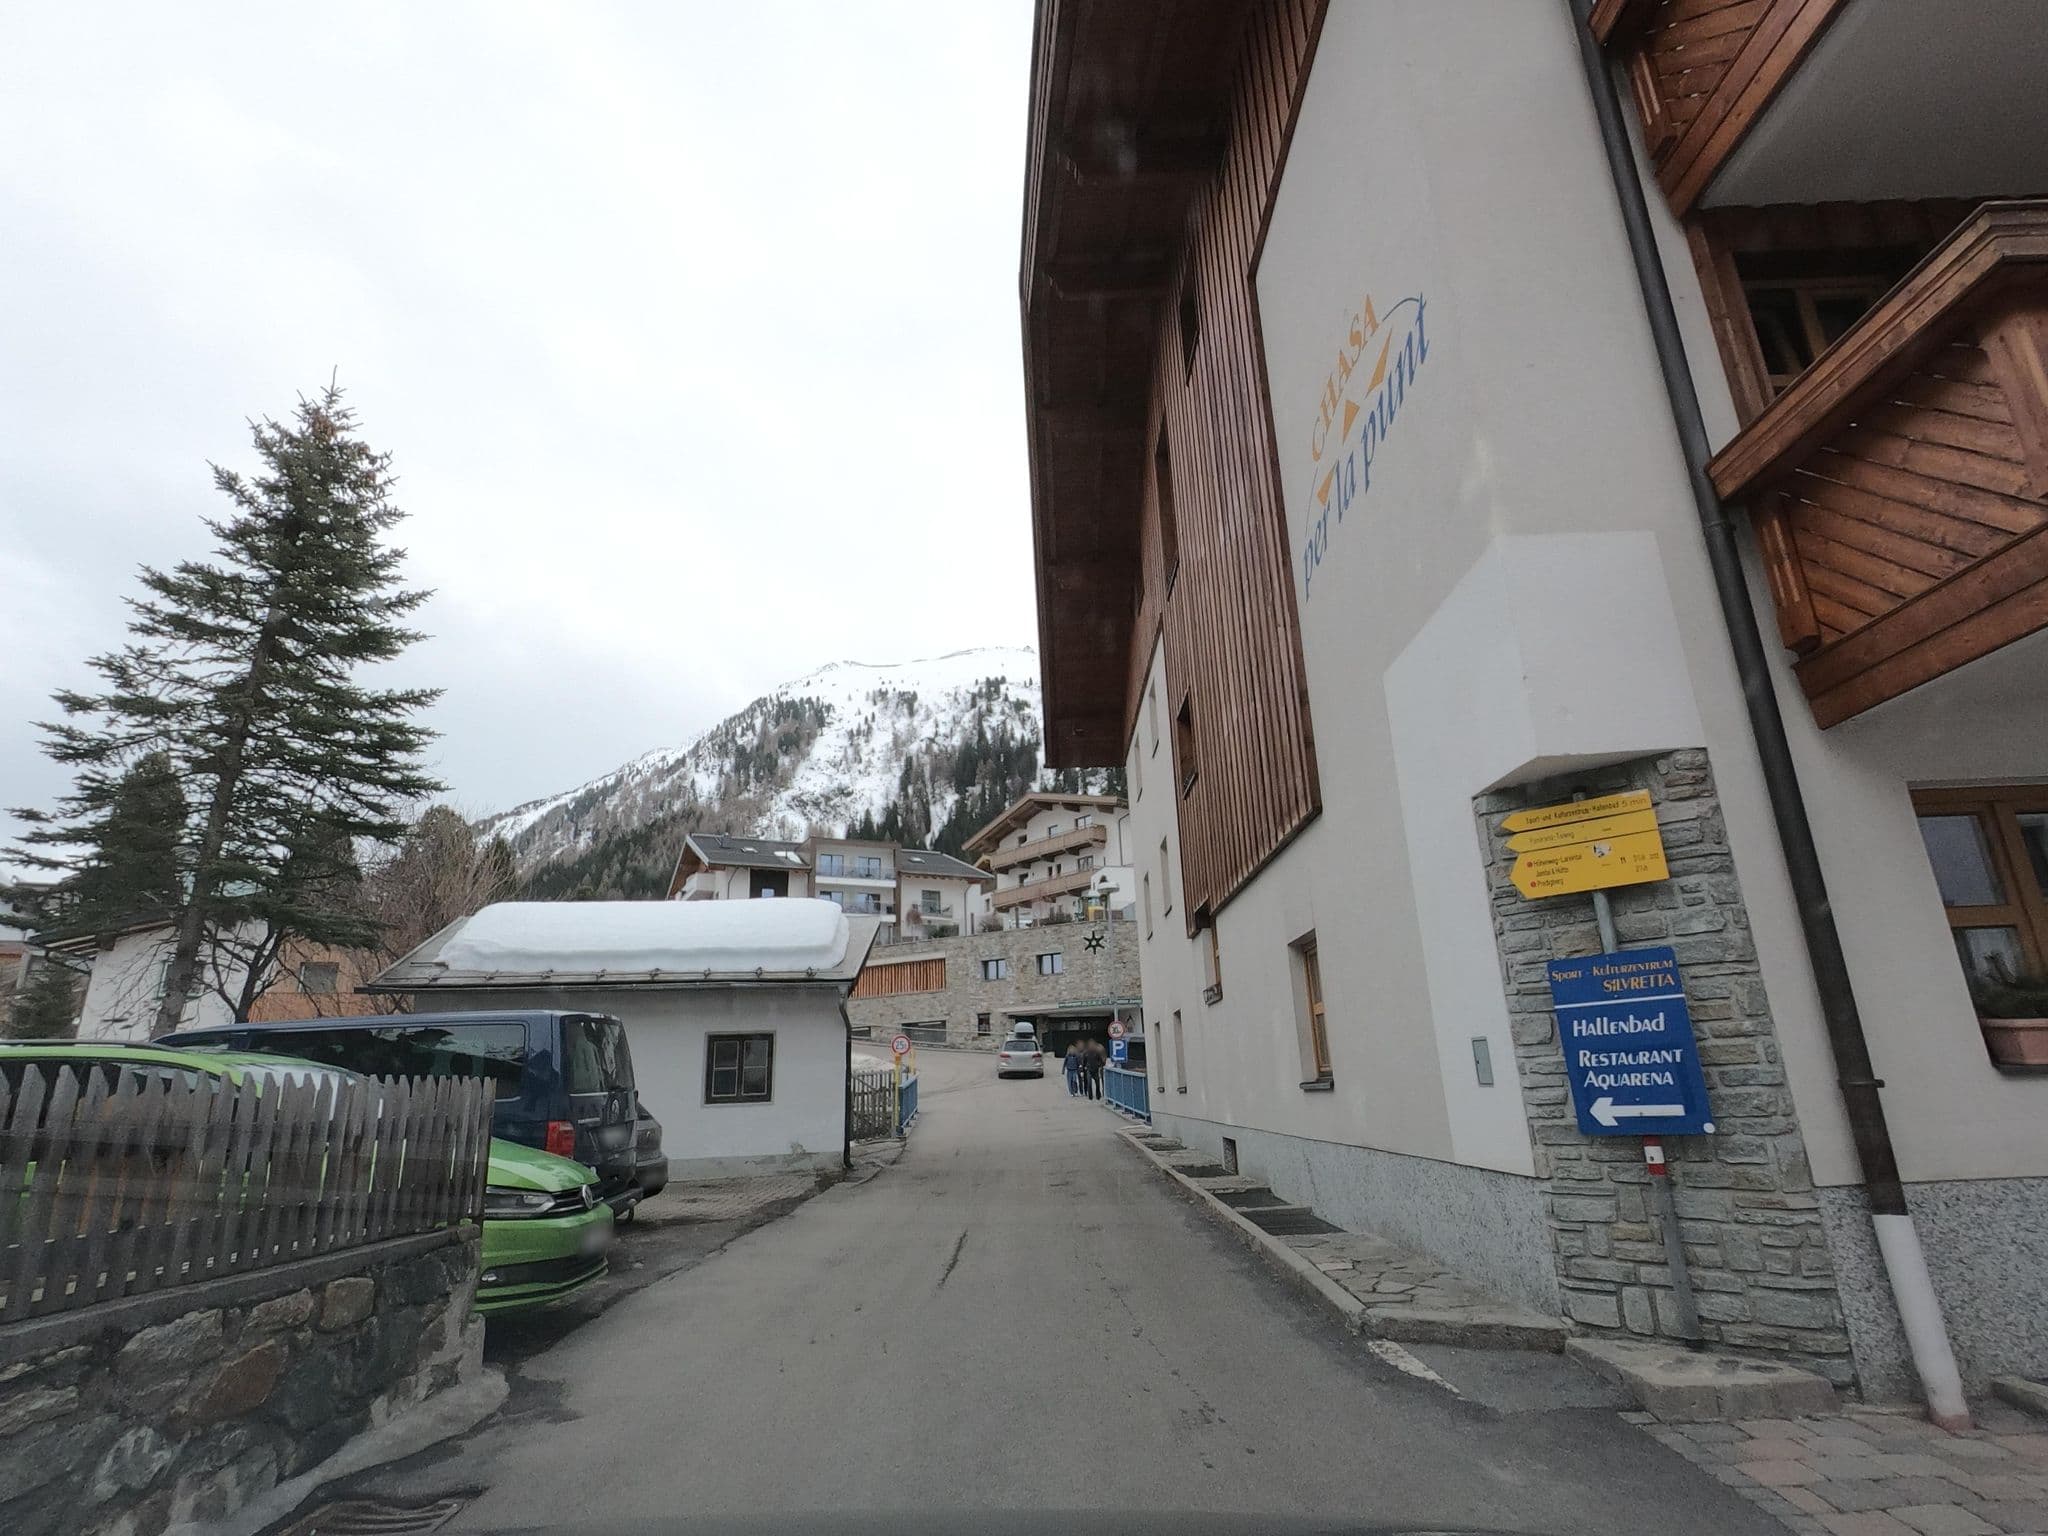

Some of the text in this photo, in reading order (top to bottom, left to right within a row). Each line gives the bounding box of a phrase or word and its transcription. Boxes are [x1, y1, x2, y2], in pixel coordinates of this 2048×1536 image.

[1303, 291, 1430, 603] per la punt
[1311, 293, 1380, 463] CHASA
[1112, 1040, 1125, 1055] P
